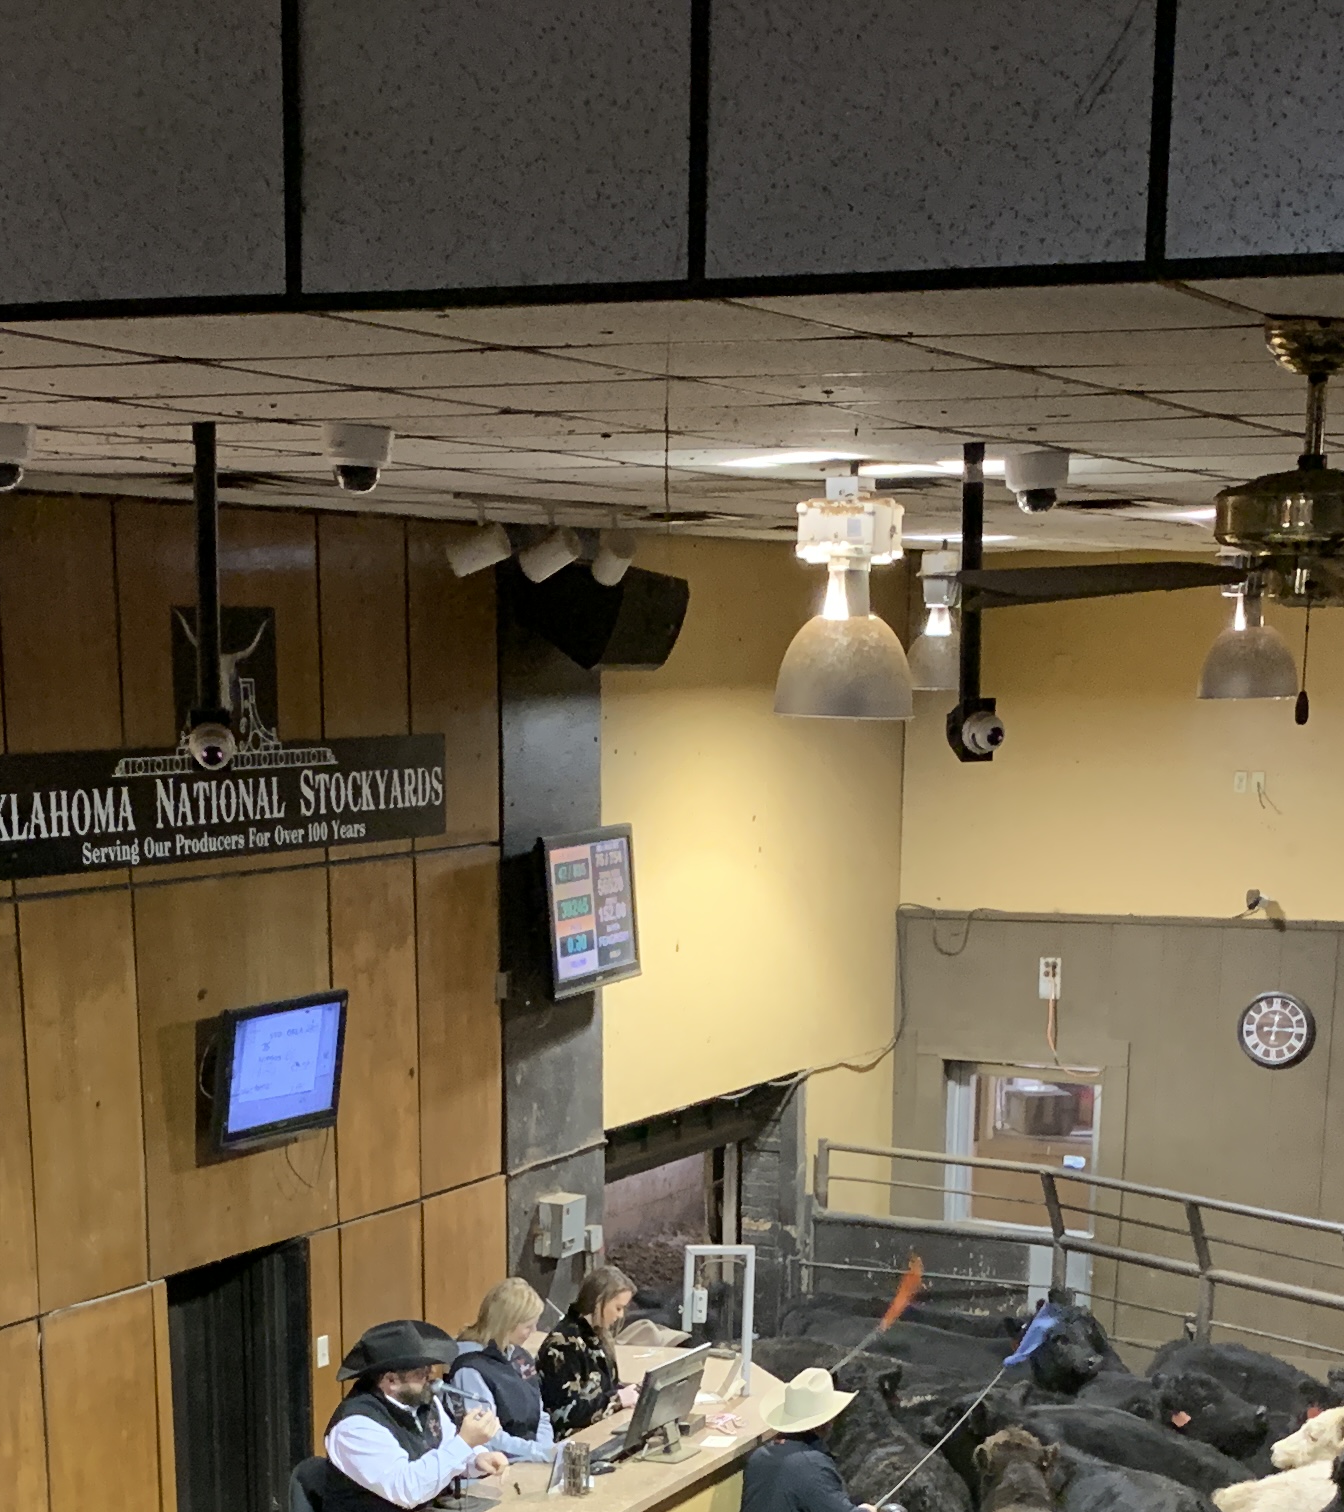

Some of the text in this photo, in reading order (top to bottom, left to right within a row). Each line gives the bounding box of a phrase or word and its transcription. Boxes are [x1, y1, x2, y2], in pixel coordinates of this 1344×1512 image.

[156, 778, 287, 830] NATIONAL
[299, 766, 444, 817] STOCKYARDS
[81, 819, 366, 866] Serving Our Producers For Over 100 Years
